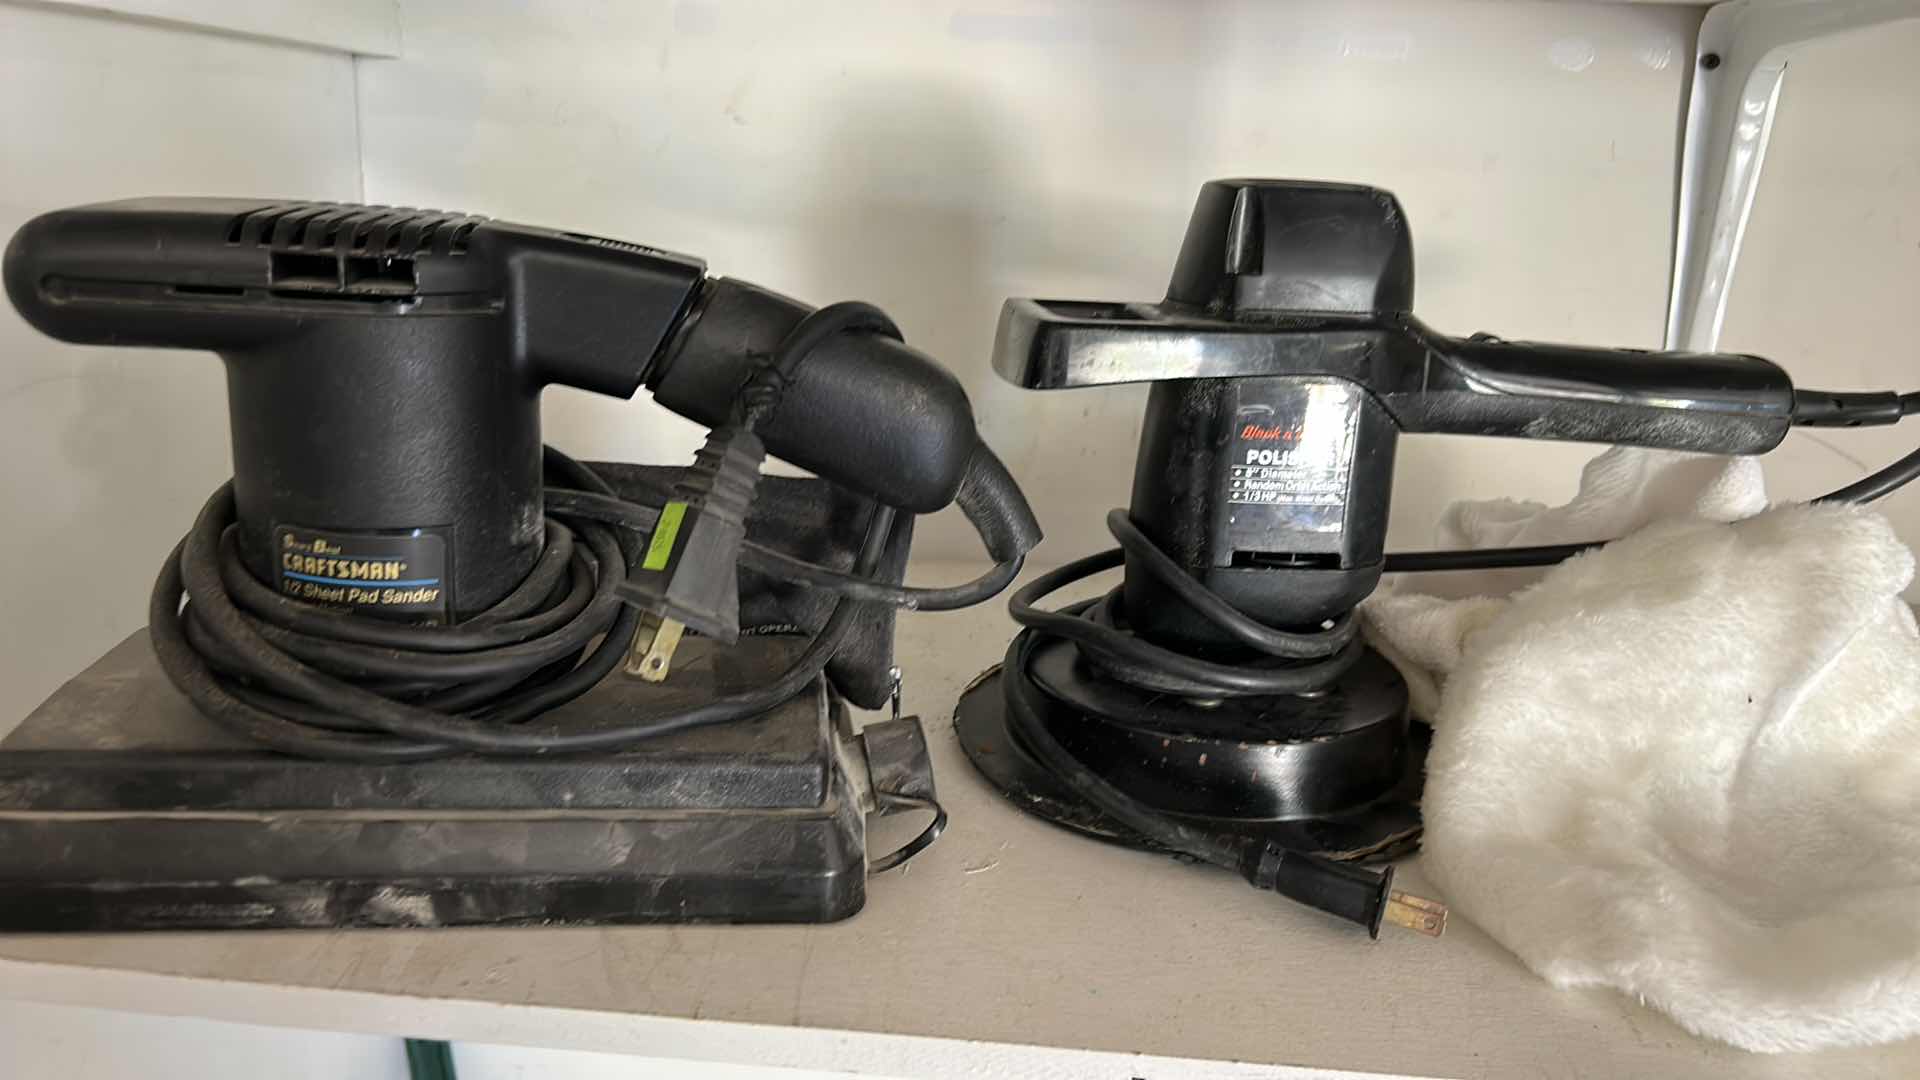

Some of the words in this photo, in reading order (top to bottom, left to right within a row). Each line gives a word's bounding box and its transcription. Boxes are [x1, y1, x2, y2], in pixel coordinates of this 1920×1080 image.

[303, 582, 345, 602] Sheet
[347, 587, 379, 605] Pad
[381, 586, 440, 605] Sander
